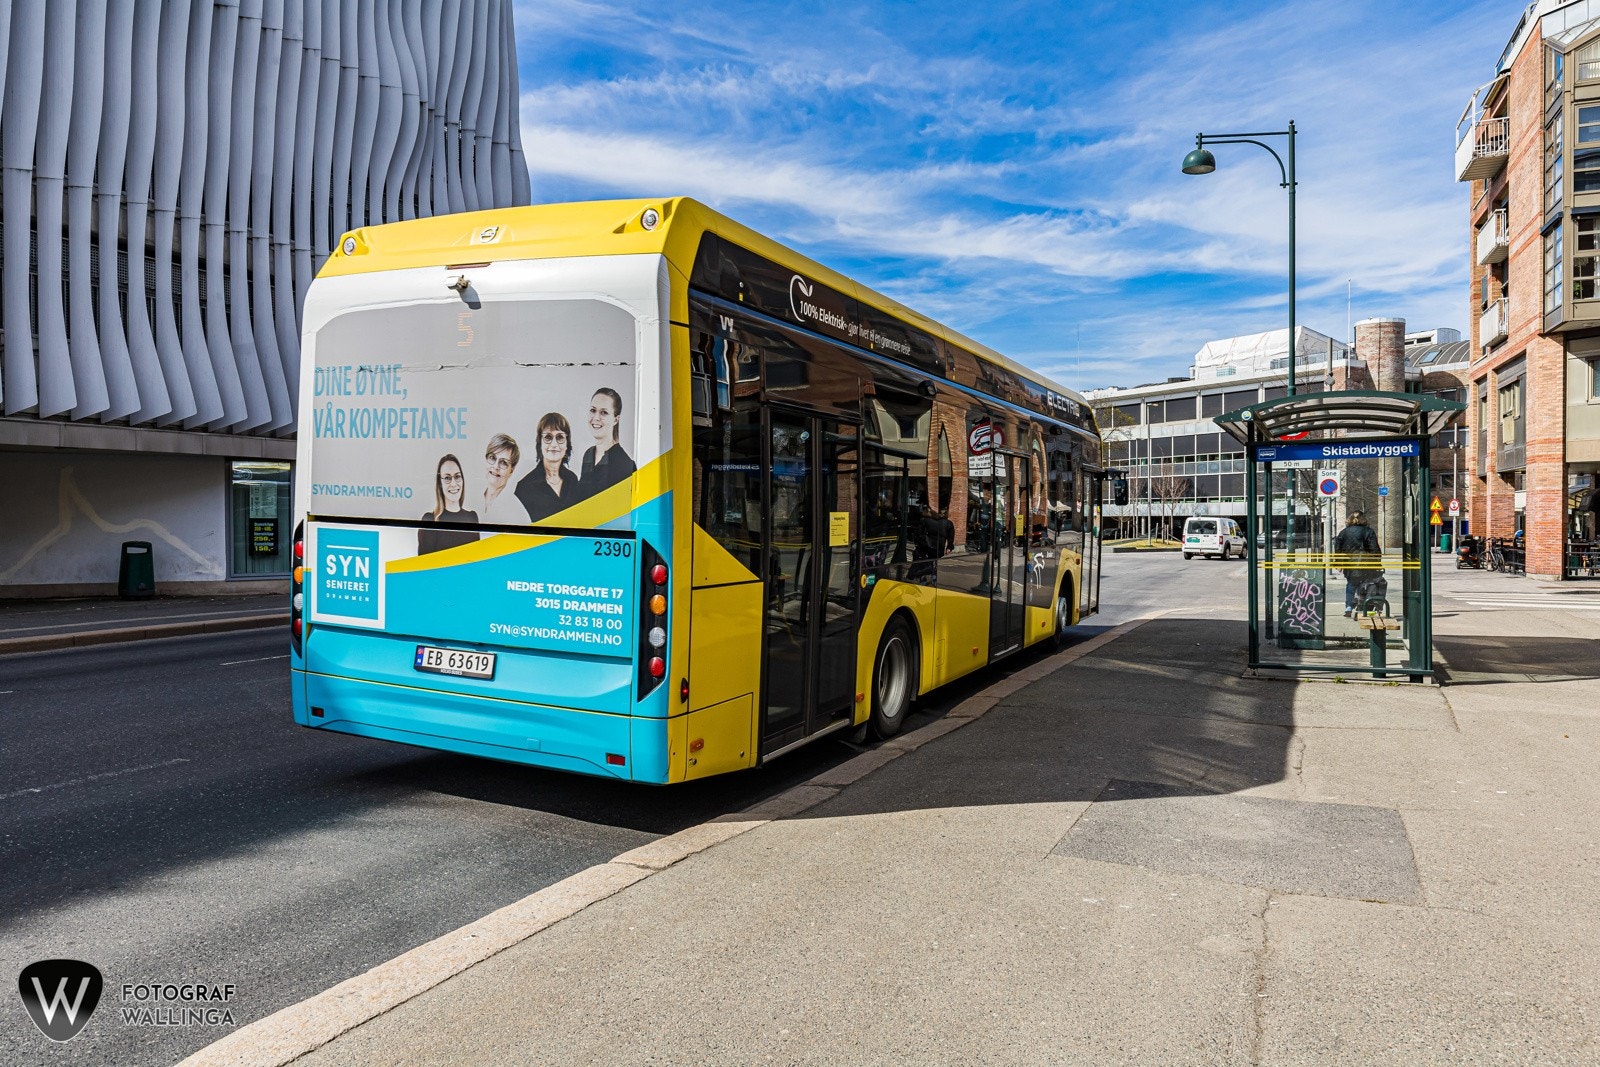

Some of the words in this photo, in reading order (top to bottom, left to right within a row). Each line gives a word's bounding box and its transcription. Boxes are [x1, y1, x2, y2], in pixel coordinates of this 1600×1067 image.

[800, 300, 819, 320] 100%
[457, 311, 473, 347] 5
[314, 365, 352, 396] DINE
[355, 363, 408, 400] ØYNE,
[313, 401, 346, 438] VÅR
[350, 406, 468, 439] KOMPETANSE
[1322, 443, 1413, 457] Skistadbygget
[312, 484, 413, 499] SYNDRAMMEN.NO
[593, 540, 631, 558] 2390
[326, 554, 370, 578] SYN
[326, 579, 370, 592] SENTERET
[507, 580, 544, 593] NEDRE
[547, 583, 609, 598] TORGGATE
[611, 588, 623, 599] 17
[535, 597, 560, 609] 3015
[563, 600, 623, 615] DRAMMEN
[559, 615, 571, 626] 32
[575, 617, 588, 627] 83
[592, 618, 602, 628] 18
[606, 619, 622, 630] 00
[490, 623, 622, 645] SYN@SYNDRAMMEN.NO
[427, 650, 443, 666] EB
[448, 653, 489, 671] 63619
